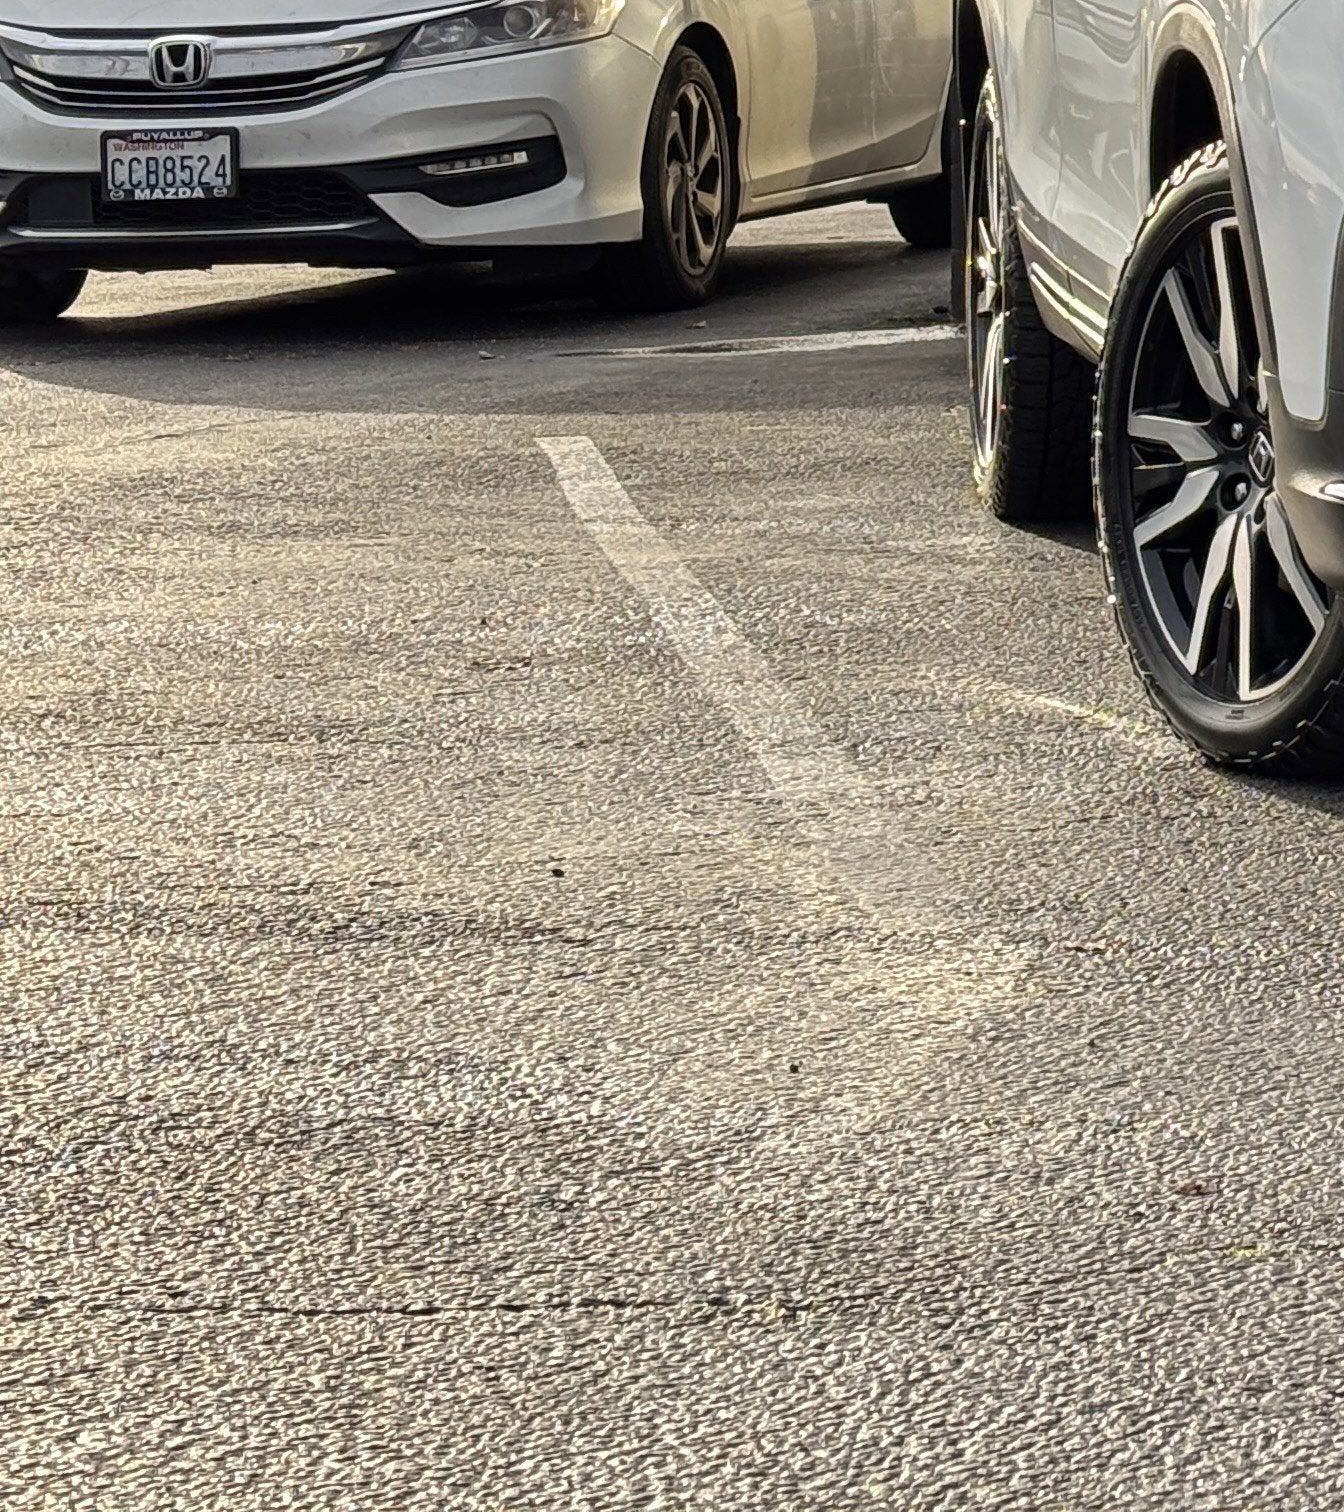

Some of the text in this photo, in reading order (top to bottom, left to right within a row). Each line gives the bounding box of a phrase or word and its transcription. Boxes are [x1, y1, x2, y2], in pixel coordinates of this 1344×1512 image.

[132, 130, 204, 141] PUYALLUP
[112, 141, 185, 152] WASHINGTON
[110, 153, 228, 189] CCB8524
[134, 187, 206, 201] MAZDA
